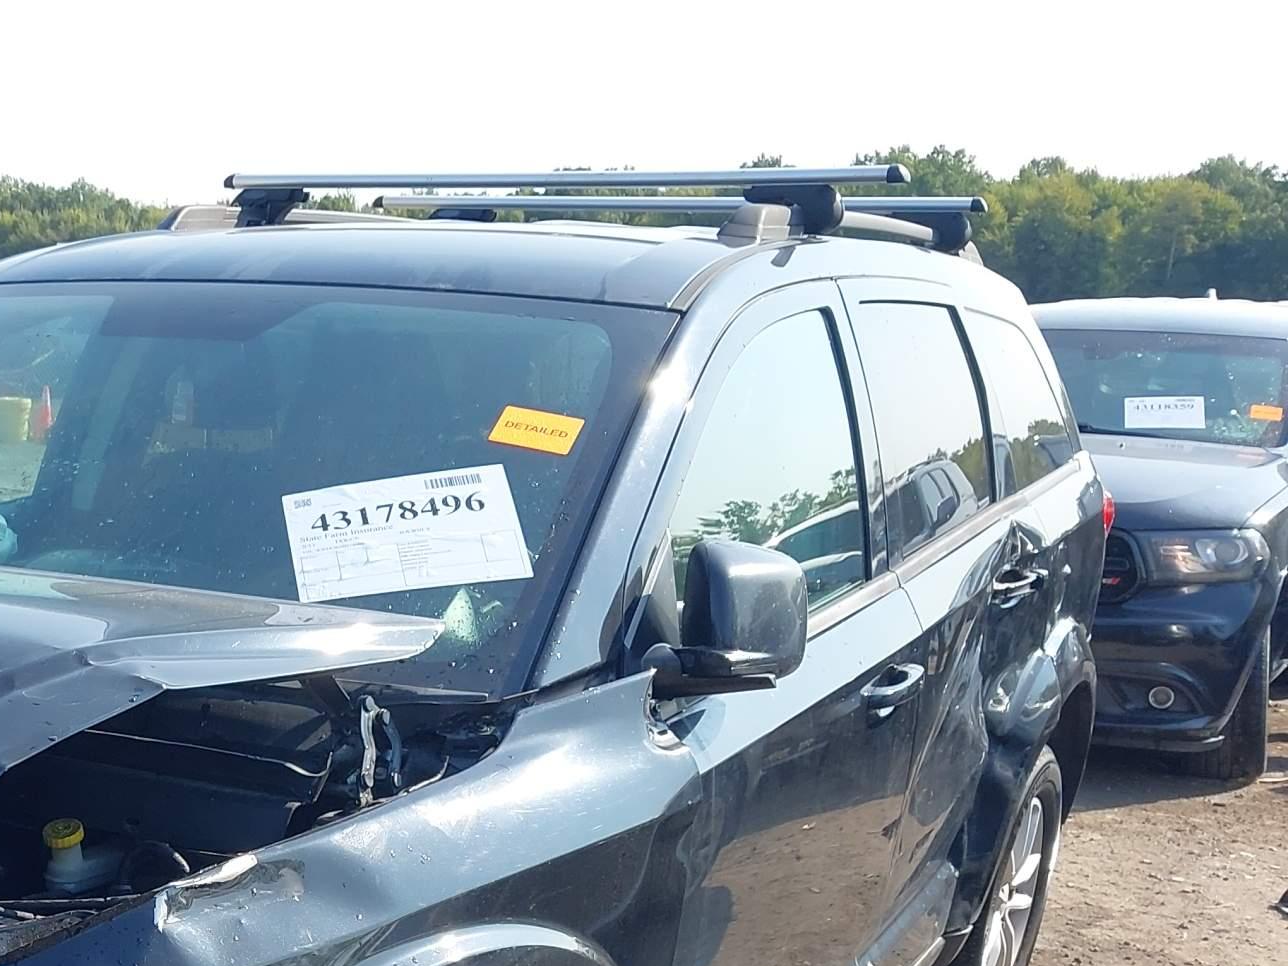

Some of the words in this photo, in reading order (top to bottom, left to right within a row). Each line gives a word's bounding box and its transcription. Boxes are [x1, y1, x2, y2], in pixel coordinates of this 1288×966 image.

[504, 420, 569, 438] DETAILED
[311, 491, 485, 532] 43178496
[324, 531, 348, 540] Farm
[350, 524, 393, 536] Insurance
